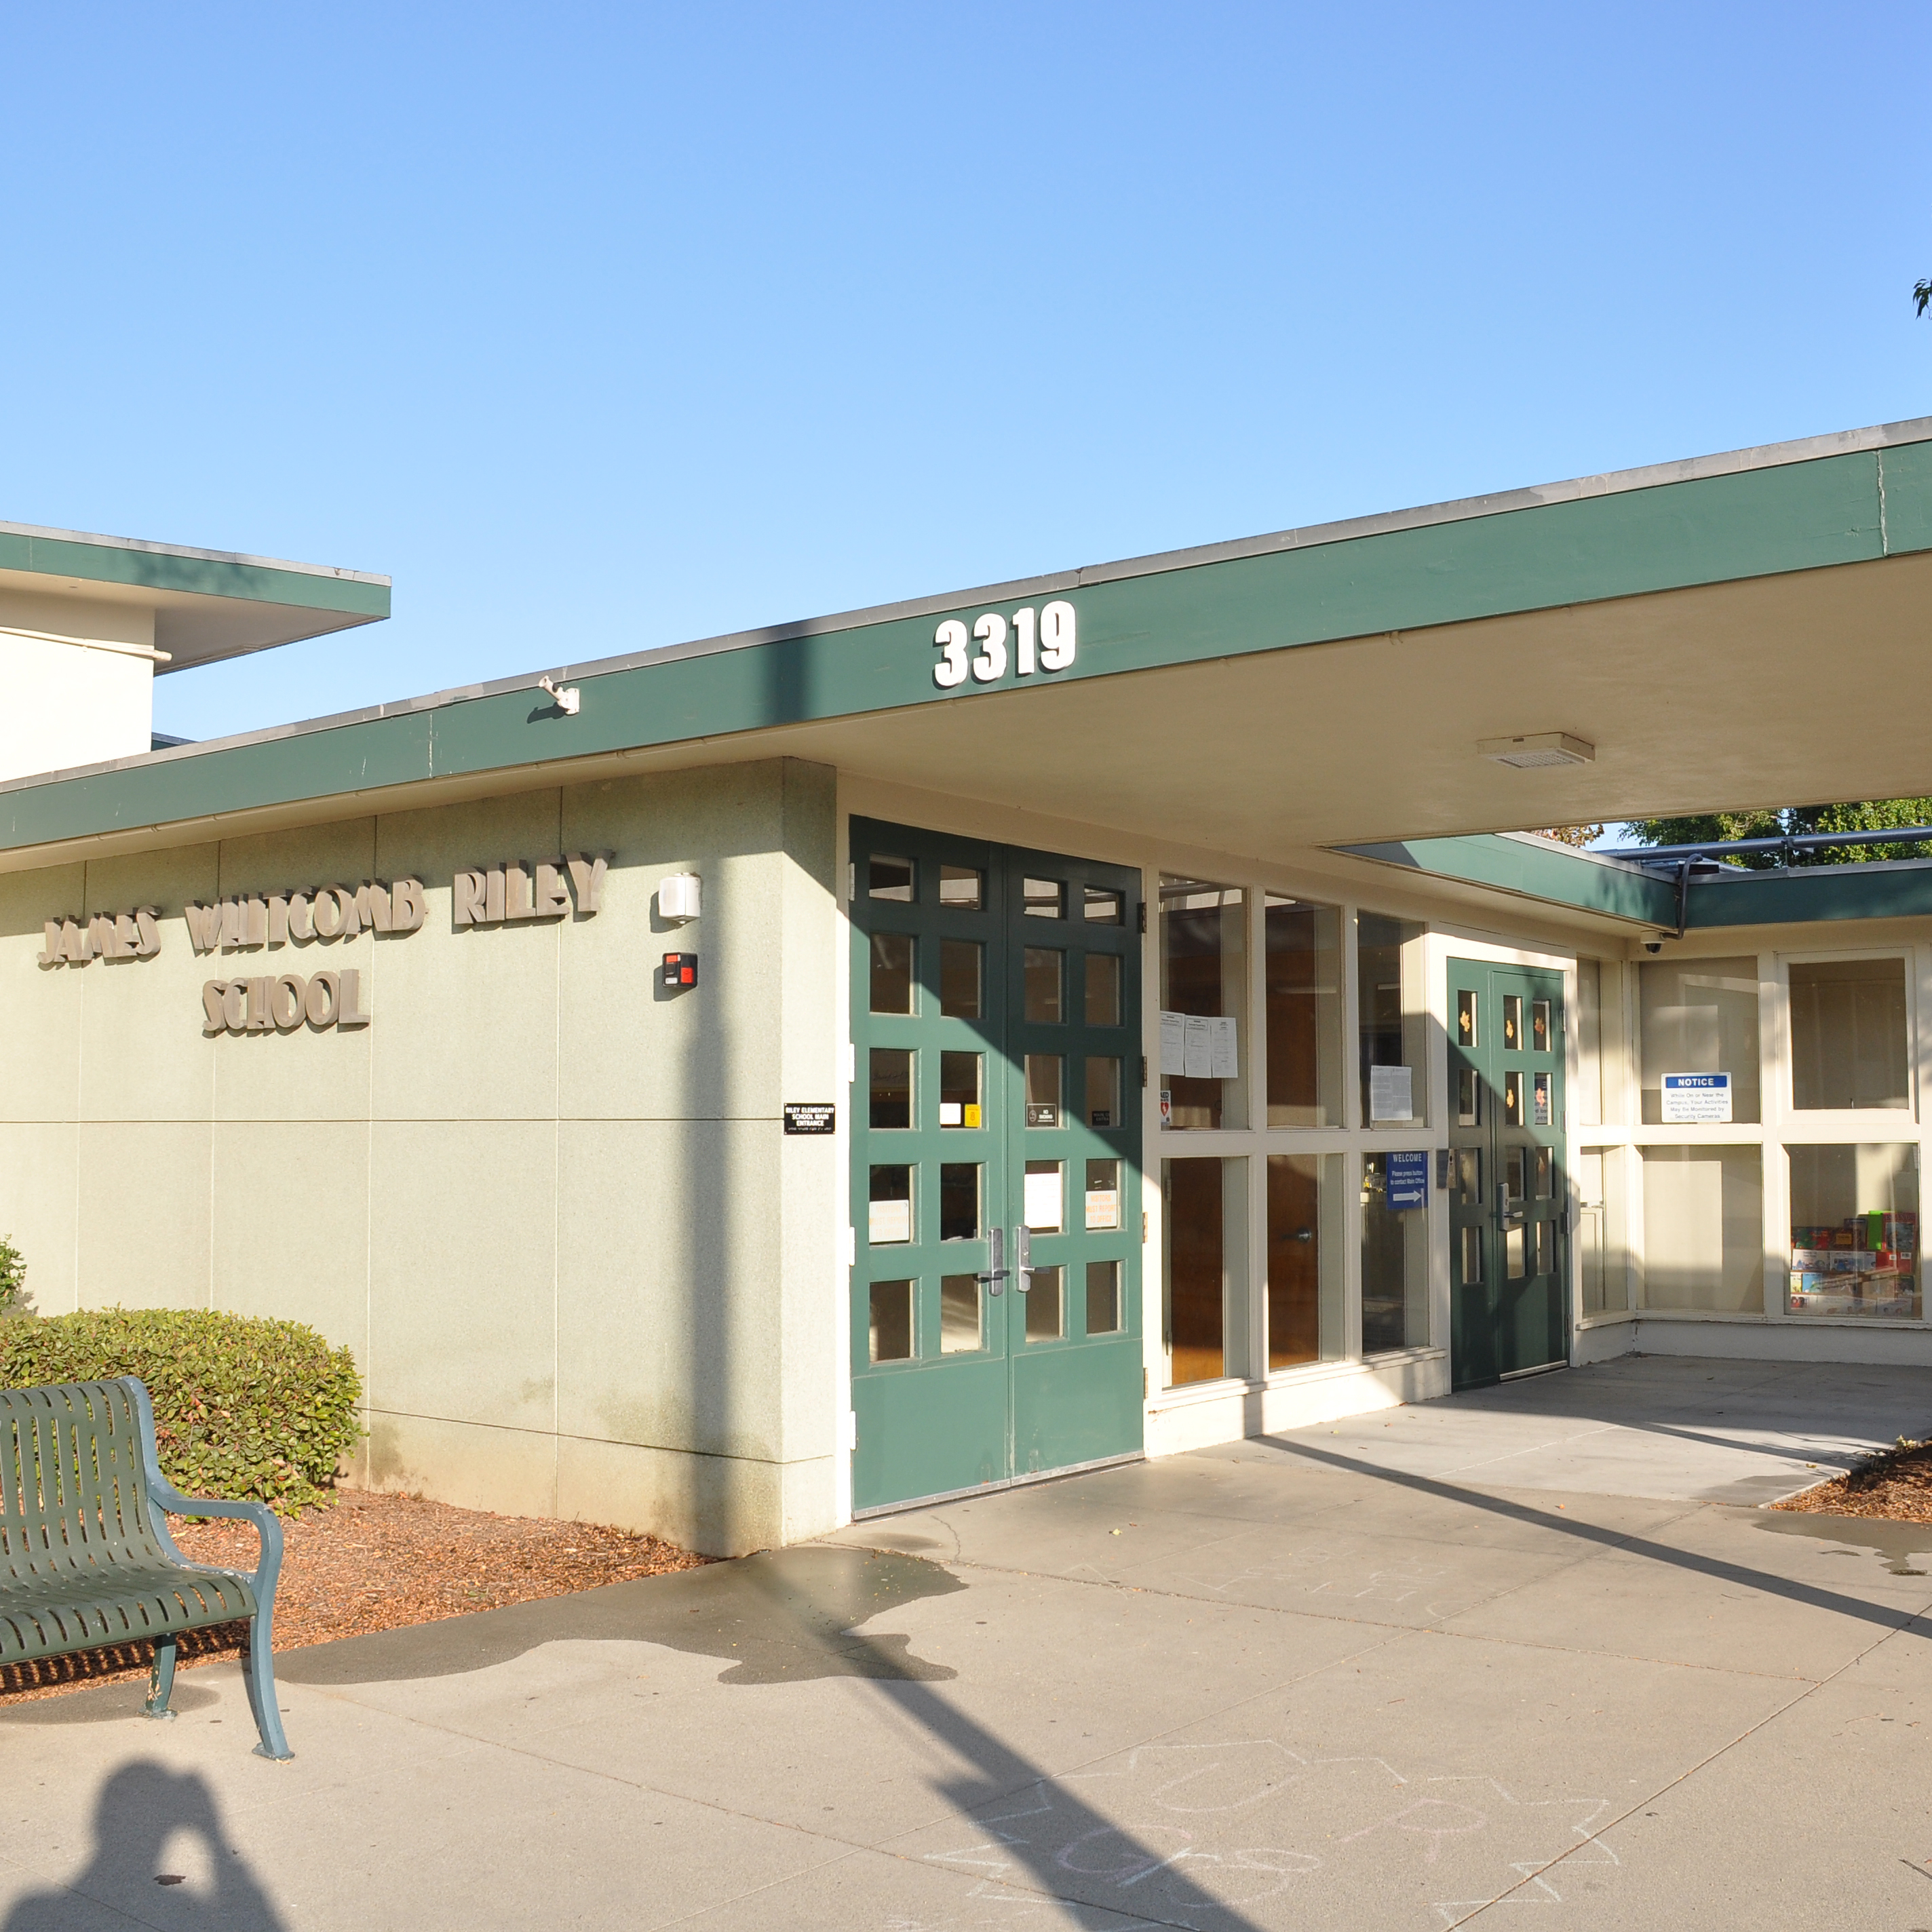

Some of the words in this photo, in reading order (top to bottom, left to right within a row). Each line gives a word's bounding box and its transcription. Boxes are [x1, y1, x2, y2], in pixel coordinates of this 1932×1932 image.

[933, 600, 1077, 687] 3319
[37, 906, 161, 967] JAMES
[185, 875, 427, 953] WHITCOMB
[453, 849, 614, 931] RILEY
[202, 969, 370, 1035] SCHOOL
[1678, 1078, 1714, 1086] NOTICE
[1393, 1153, 1422, 1162] WELCOME
[1100, 1204, 1117, 1212] REPORT
